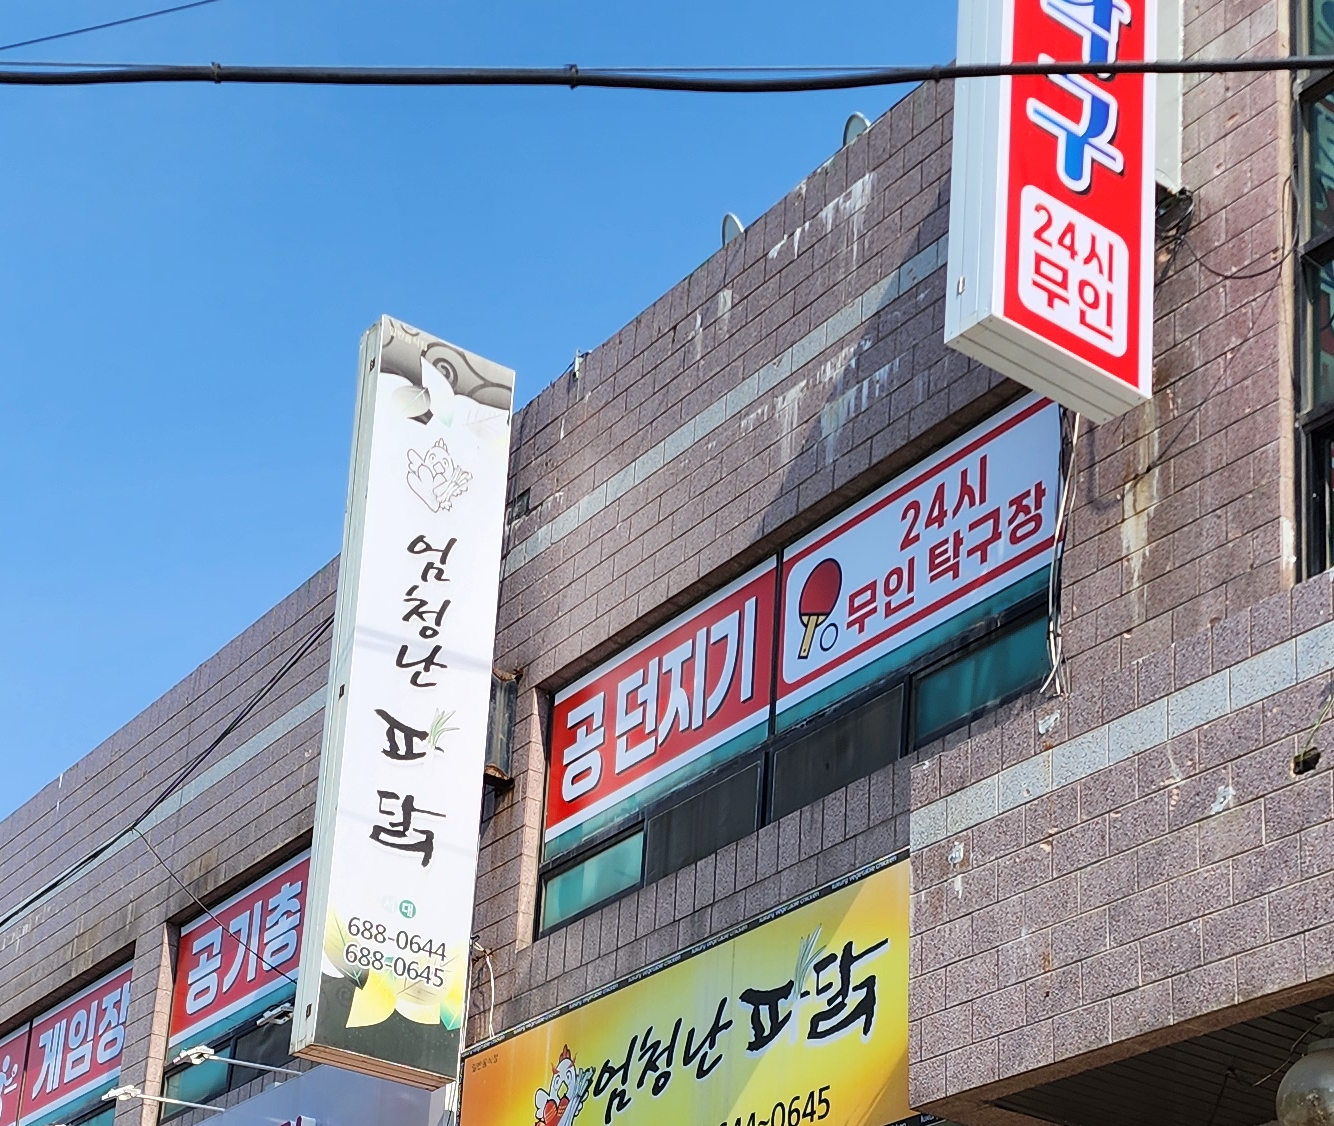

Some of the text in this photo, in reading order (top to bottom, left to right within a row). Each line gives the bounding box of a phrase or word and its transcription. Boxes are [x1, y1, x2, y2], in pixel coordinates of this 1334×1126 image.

[1031, 252, 1114, 344] 무인
[1032, 202, 1115, 286] 24시
[846, 480, 1048, 635] 무인 탁구장
[899, 454, 988, 552] 24시
[394, 535, 458, 689] 엄청난
[562, 597, 758, 804] 공던지기
[369, 708, 449, 868] 파닭
[185, 880, 303, 1015] 공기총
[345, 943, 445, 988] 688-0645
[347, 916, 448, 961] 688-0644
[32, 980, 132, 1100] 게임장
[592, 937, 889, 1124] 엄청난 파닭
